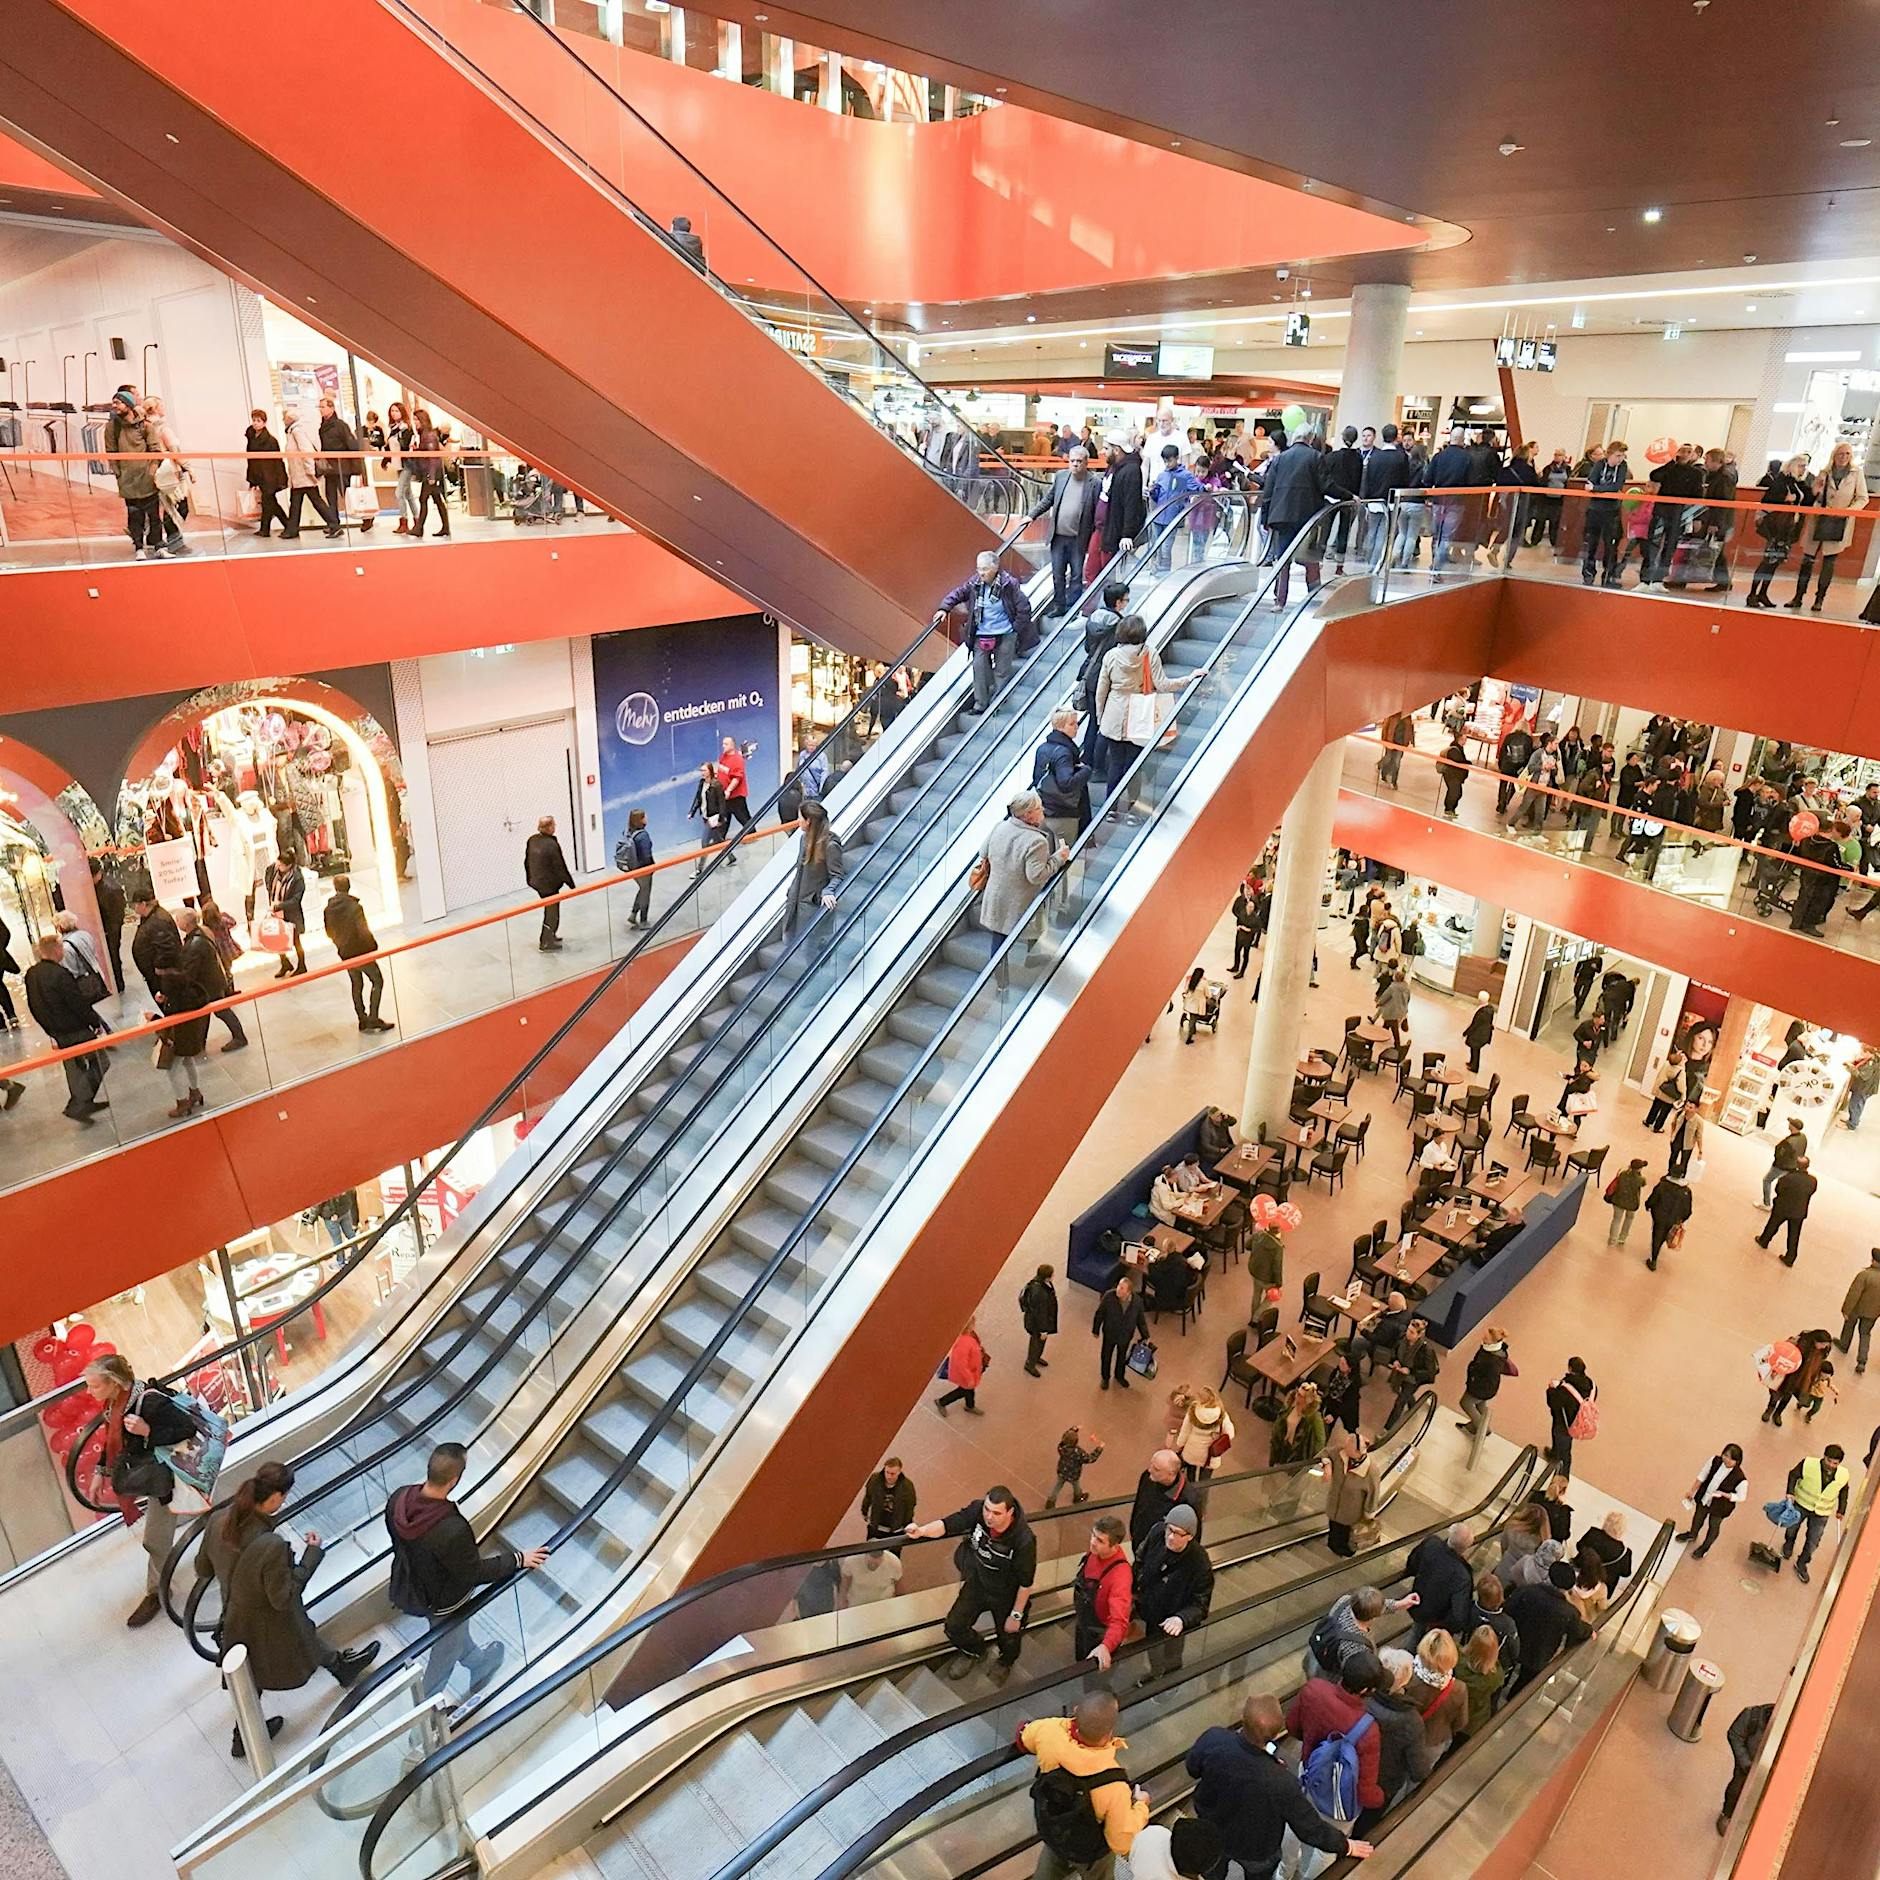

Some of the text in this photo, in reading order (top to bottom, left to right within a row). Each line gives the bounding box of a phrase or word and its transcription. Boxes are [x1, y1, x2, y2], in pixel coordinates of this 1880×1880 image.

[618, 699, 657, 732] Mehr
[664, 700, 726, 723] entdecken
[727, 693, 748, 710] mit
